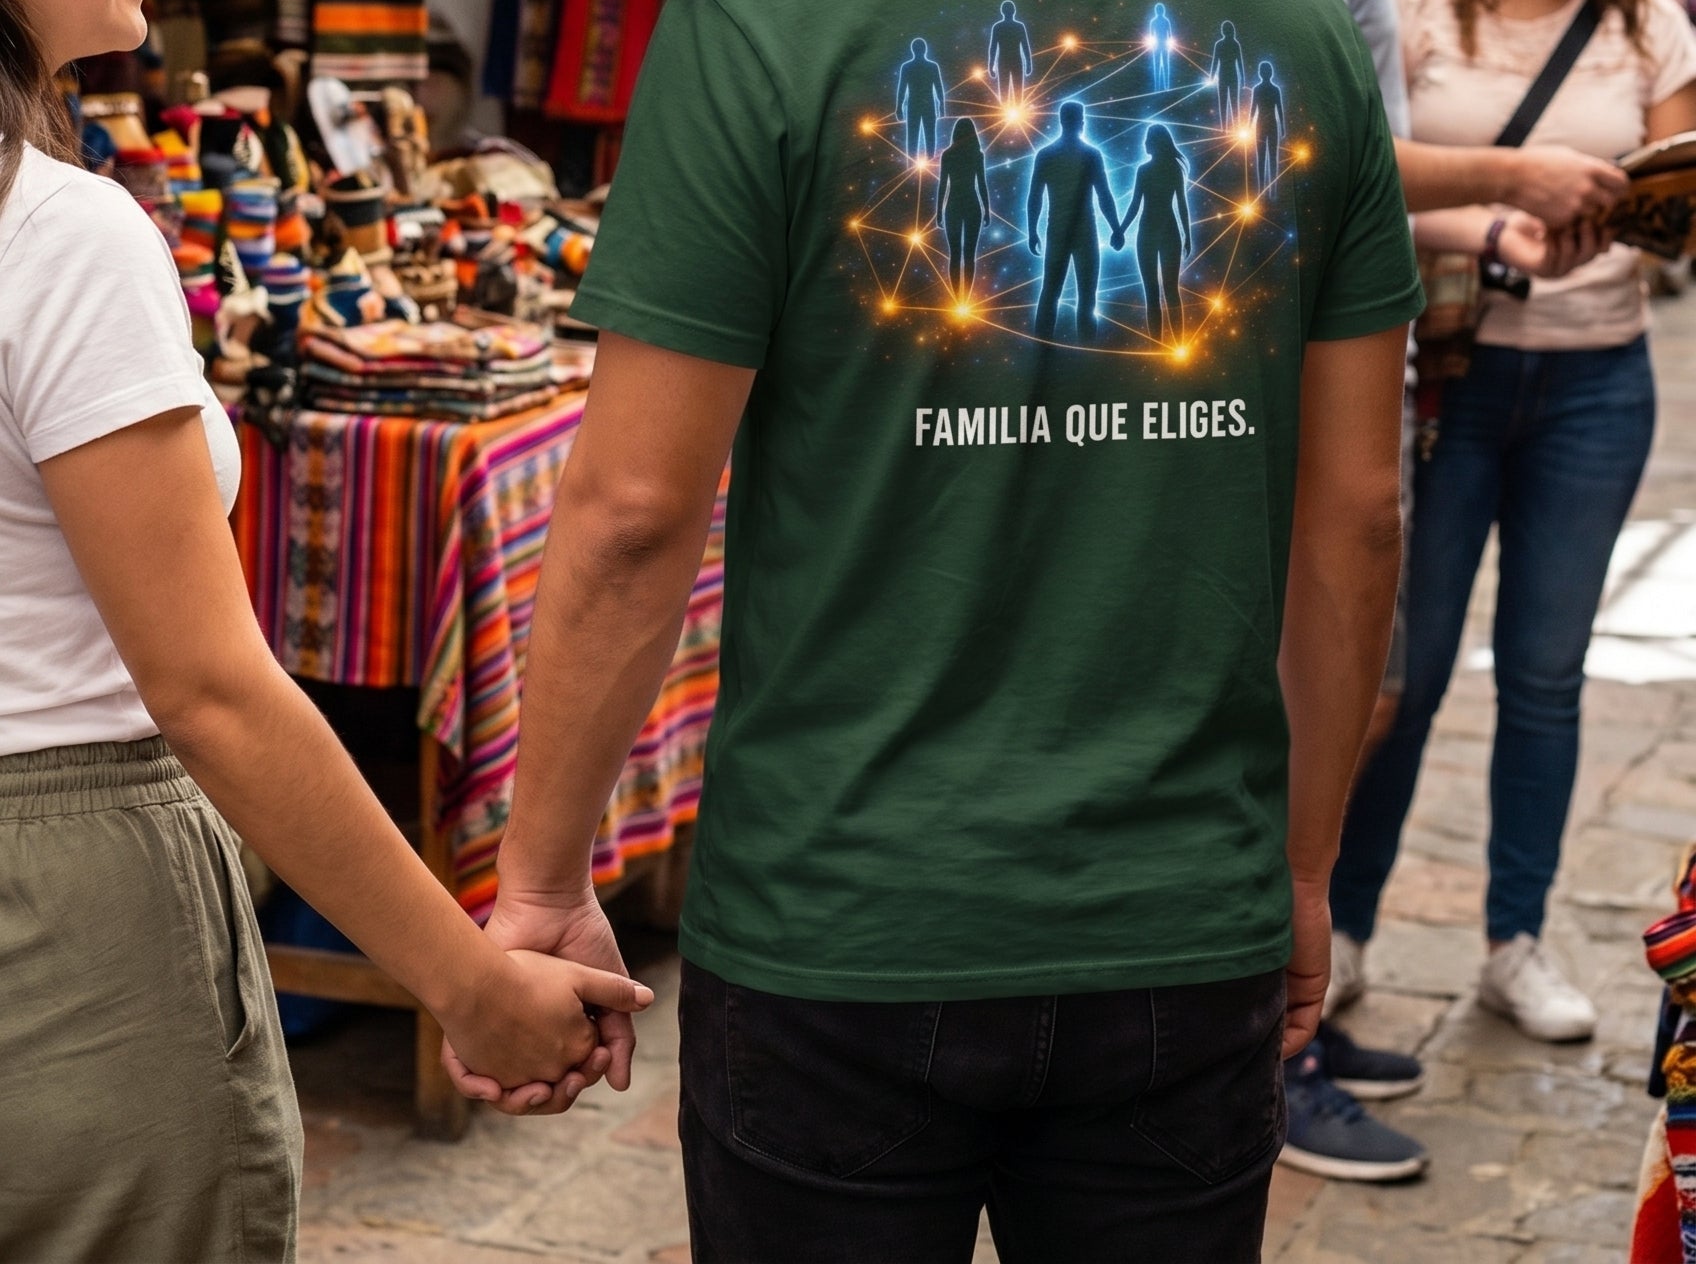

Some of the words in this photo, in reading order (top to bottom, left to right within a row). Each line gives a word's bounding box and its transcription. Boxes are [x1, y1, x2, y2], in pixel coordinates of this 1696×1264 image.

[915, 405, 1051, 446] FAMILIA
[1065, 403, 1128, 447] QUE
[1142, 398, 1255, 440] ELIGES.
